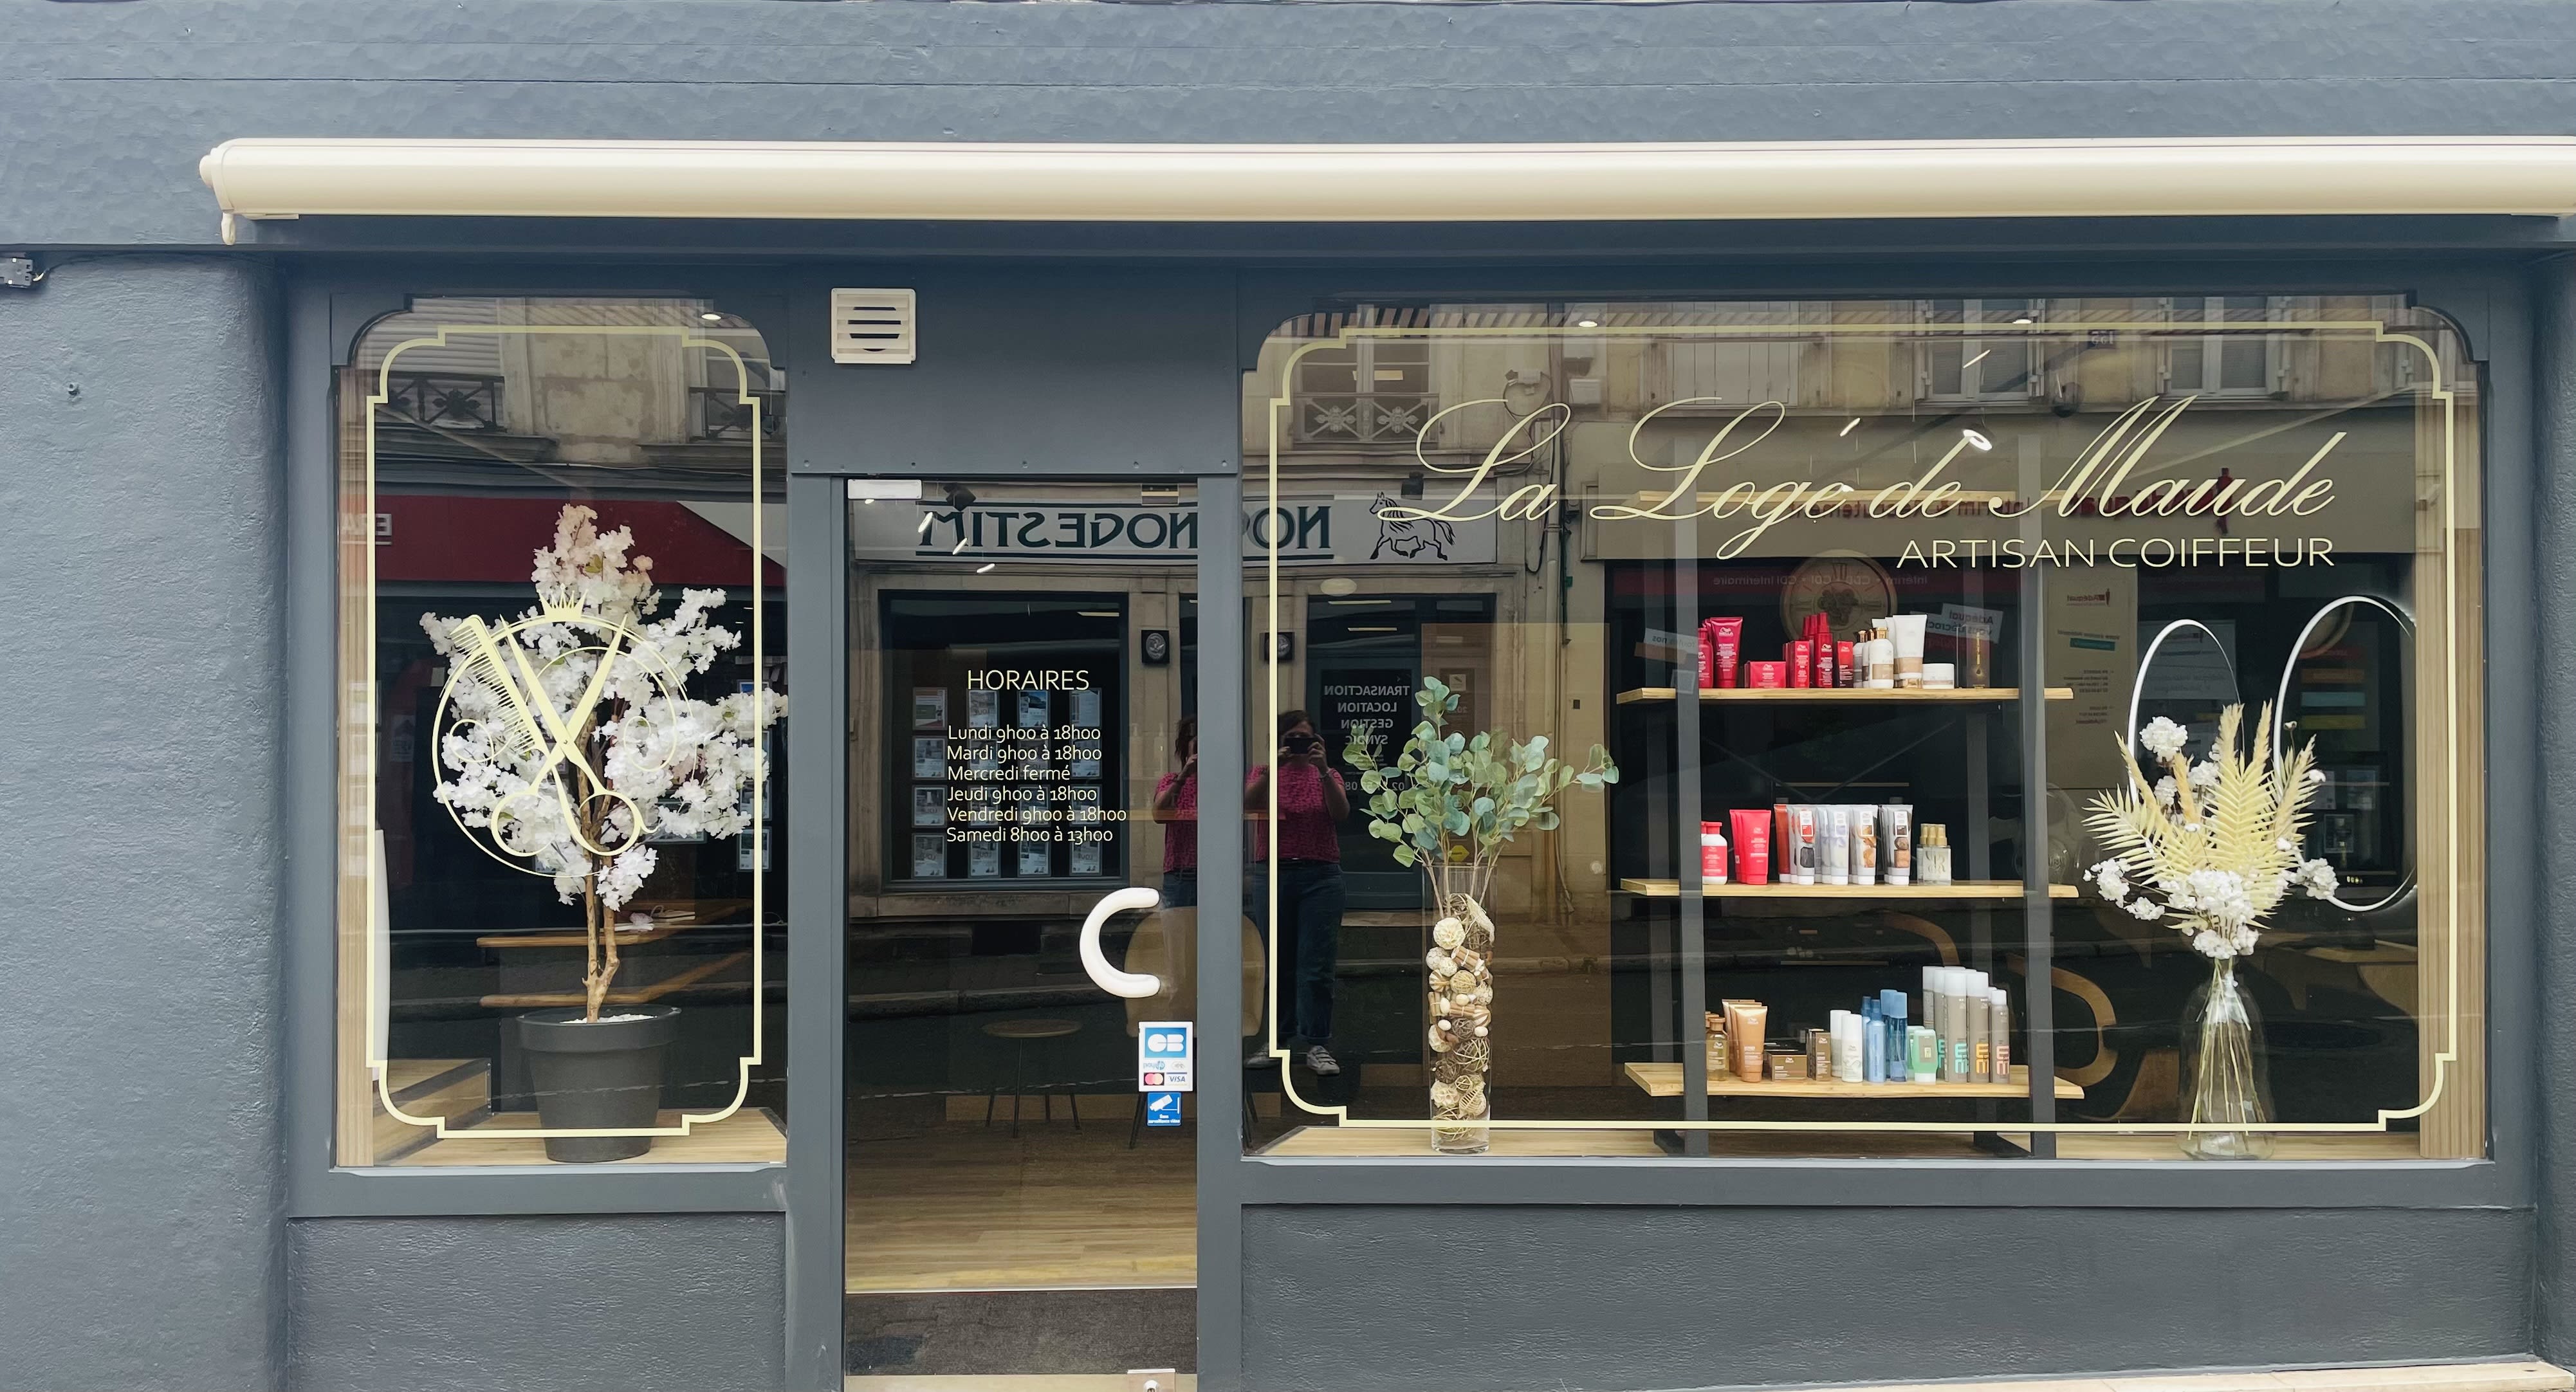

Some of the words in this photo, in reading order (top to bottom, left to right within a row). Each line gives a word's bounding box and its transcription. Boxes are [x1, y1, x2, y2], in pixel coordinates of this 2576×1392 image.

[1377, 398, 1571, 522] La
[1589, 396, 1847, 560] Loge
[1868, 435, 1971, 518] de
[1988, 394, 2348, 518] Maude
[1897, 539, 2096, 569] ARTISAN
[2109, 538, 2335, 569] COIFFEUR
[968, 670, 1090, 691] HORAIRES
[948, 724, 991, 740] Lundi
[1040, 724, 1049, 740] à
[948, 745, 993, 760] Mardi
[1041, 744, 1050, 760] à
[948, 764, 1018, 780] Mercredi
[1023, 764, 1071, 780] fermé
[948, 785, 988, 801] Jeudi
[1036, 785, 1045, 801] à
[948, 805, 1018, 821] Vendredi
[1067, 805, 1075, 821] à
[947, 826, 1006, 841] Samedi
[1054, 826, 1063, 841] à
[1147, 1034, 1184, 1052] CB
